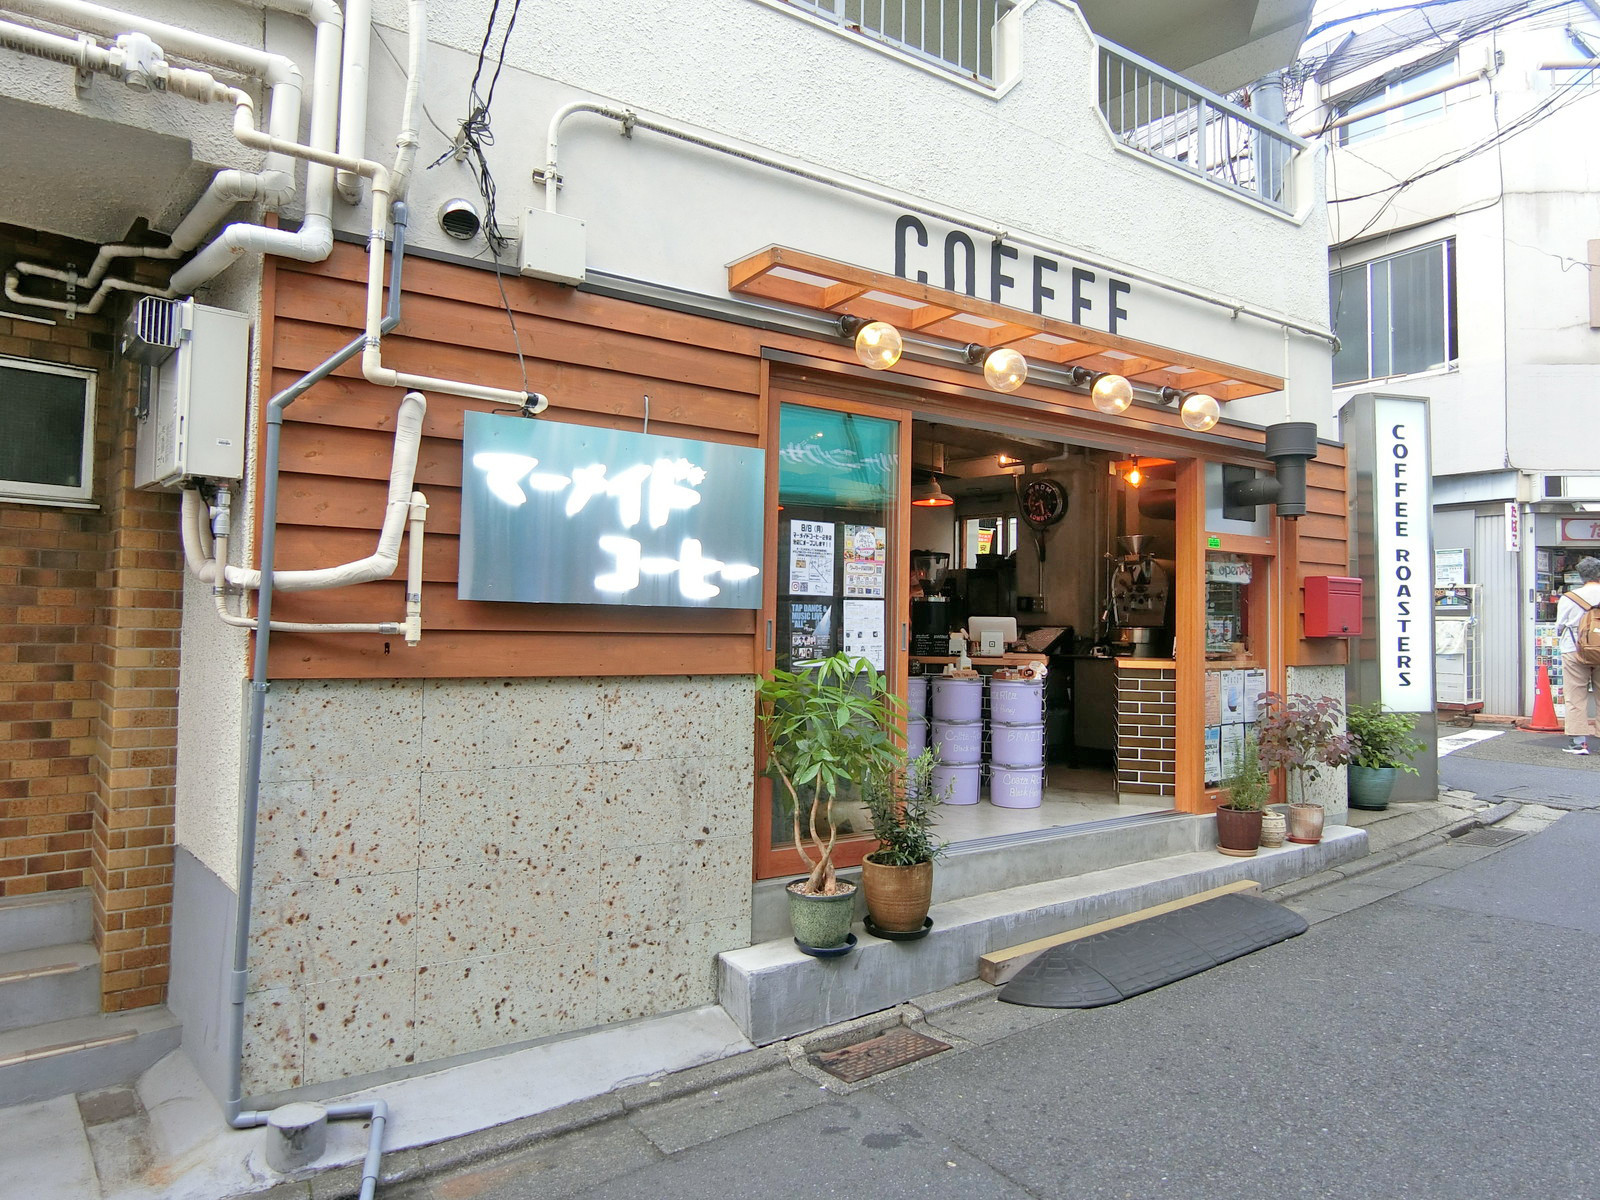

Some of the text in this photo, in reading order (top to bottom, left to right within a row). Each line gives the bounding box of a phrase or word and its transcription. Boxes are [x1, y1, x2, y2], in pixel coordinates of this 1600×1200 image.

[895, 215, 1131, 334] COFFEE
[595, 538, 760, 599] コーヒー
[1392, 425, 1412, 687] COFFEE ROASTERS
[792, 604, 803, 612] TAP
[804, 604, 823, 612] DANCE
[792, 612, 811, 620] MUSIC
